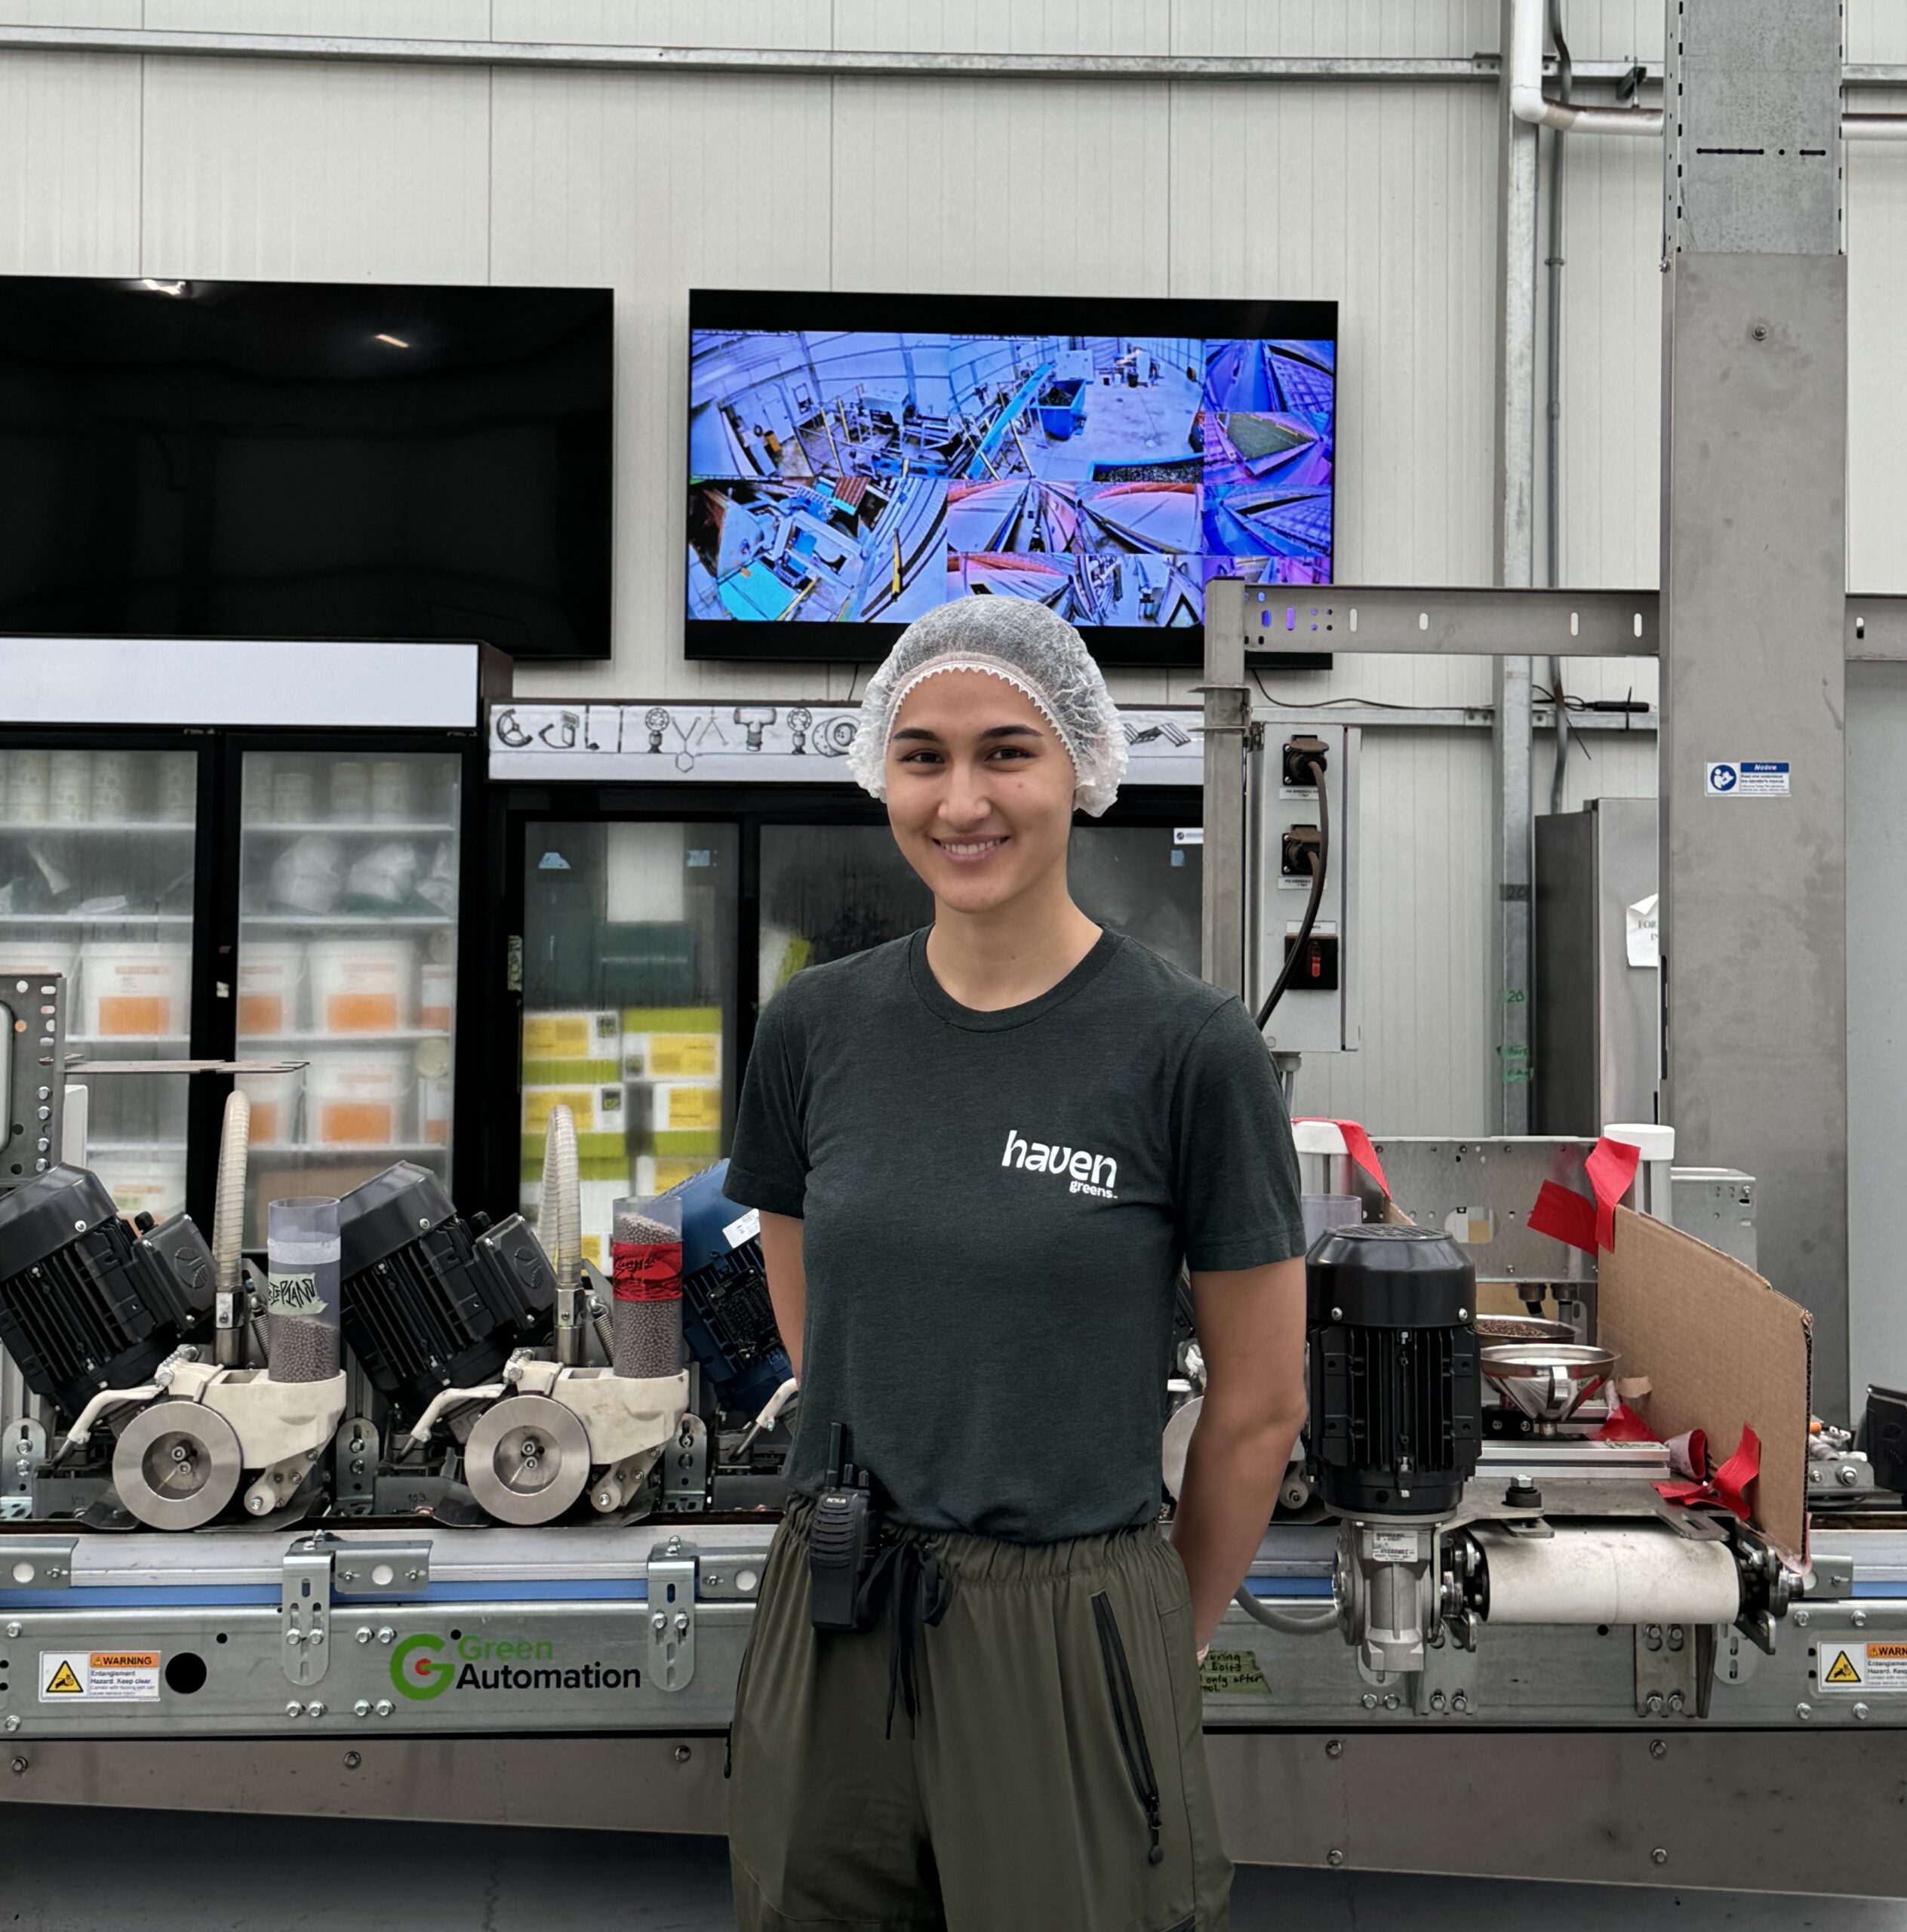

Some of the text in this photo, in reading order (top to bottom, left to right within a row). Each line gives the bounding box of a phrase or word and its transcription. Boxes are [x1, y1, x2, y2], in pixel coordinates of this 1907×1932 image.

[1507, 989, 1524, 1003] 20
[1001, 1130, 1117, 1188] haven
[457, 1635, 554, 1660] Green
[103, 1657, 152, 1665] WARNING
[1205, 1652, 1241, 1664] uring
[456, 1661, 641, 1690] Automation
